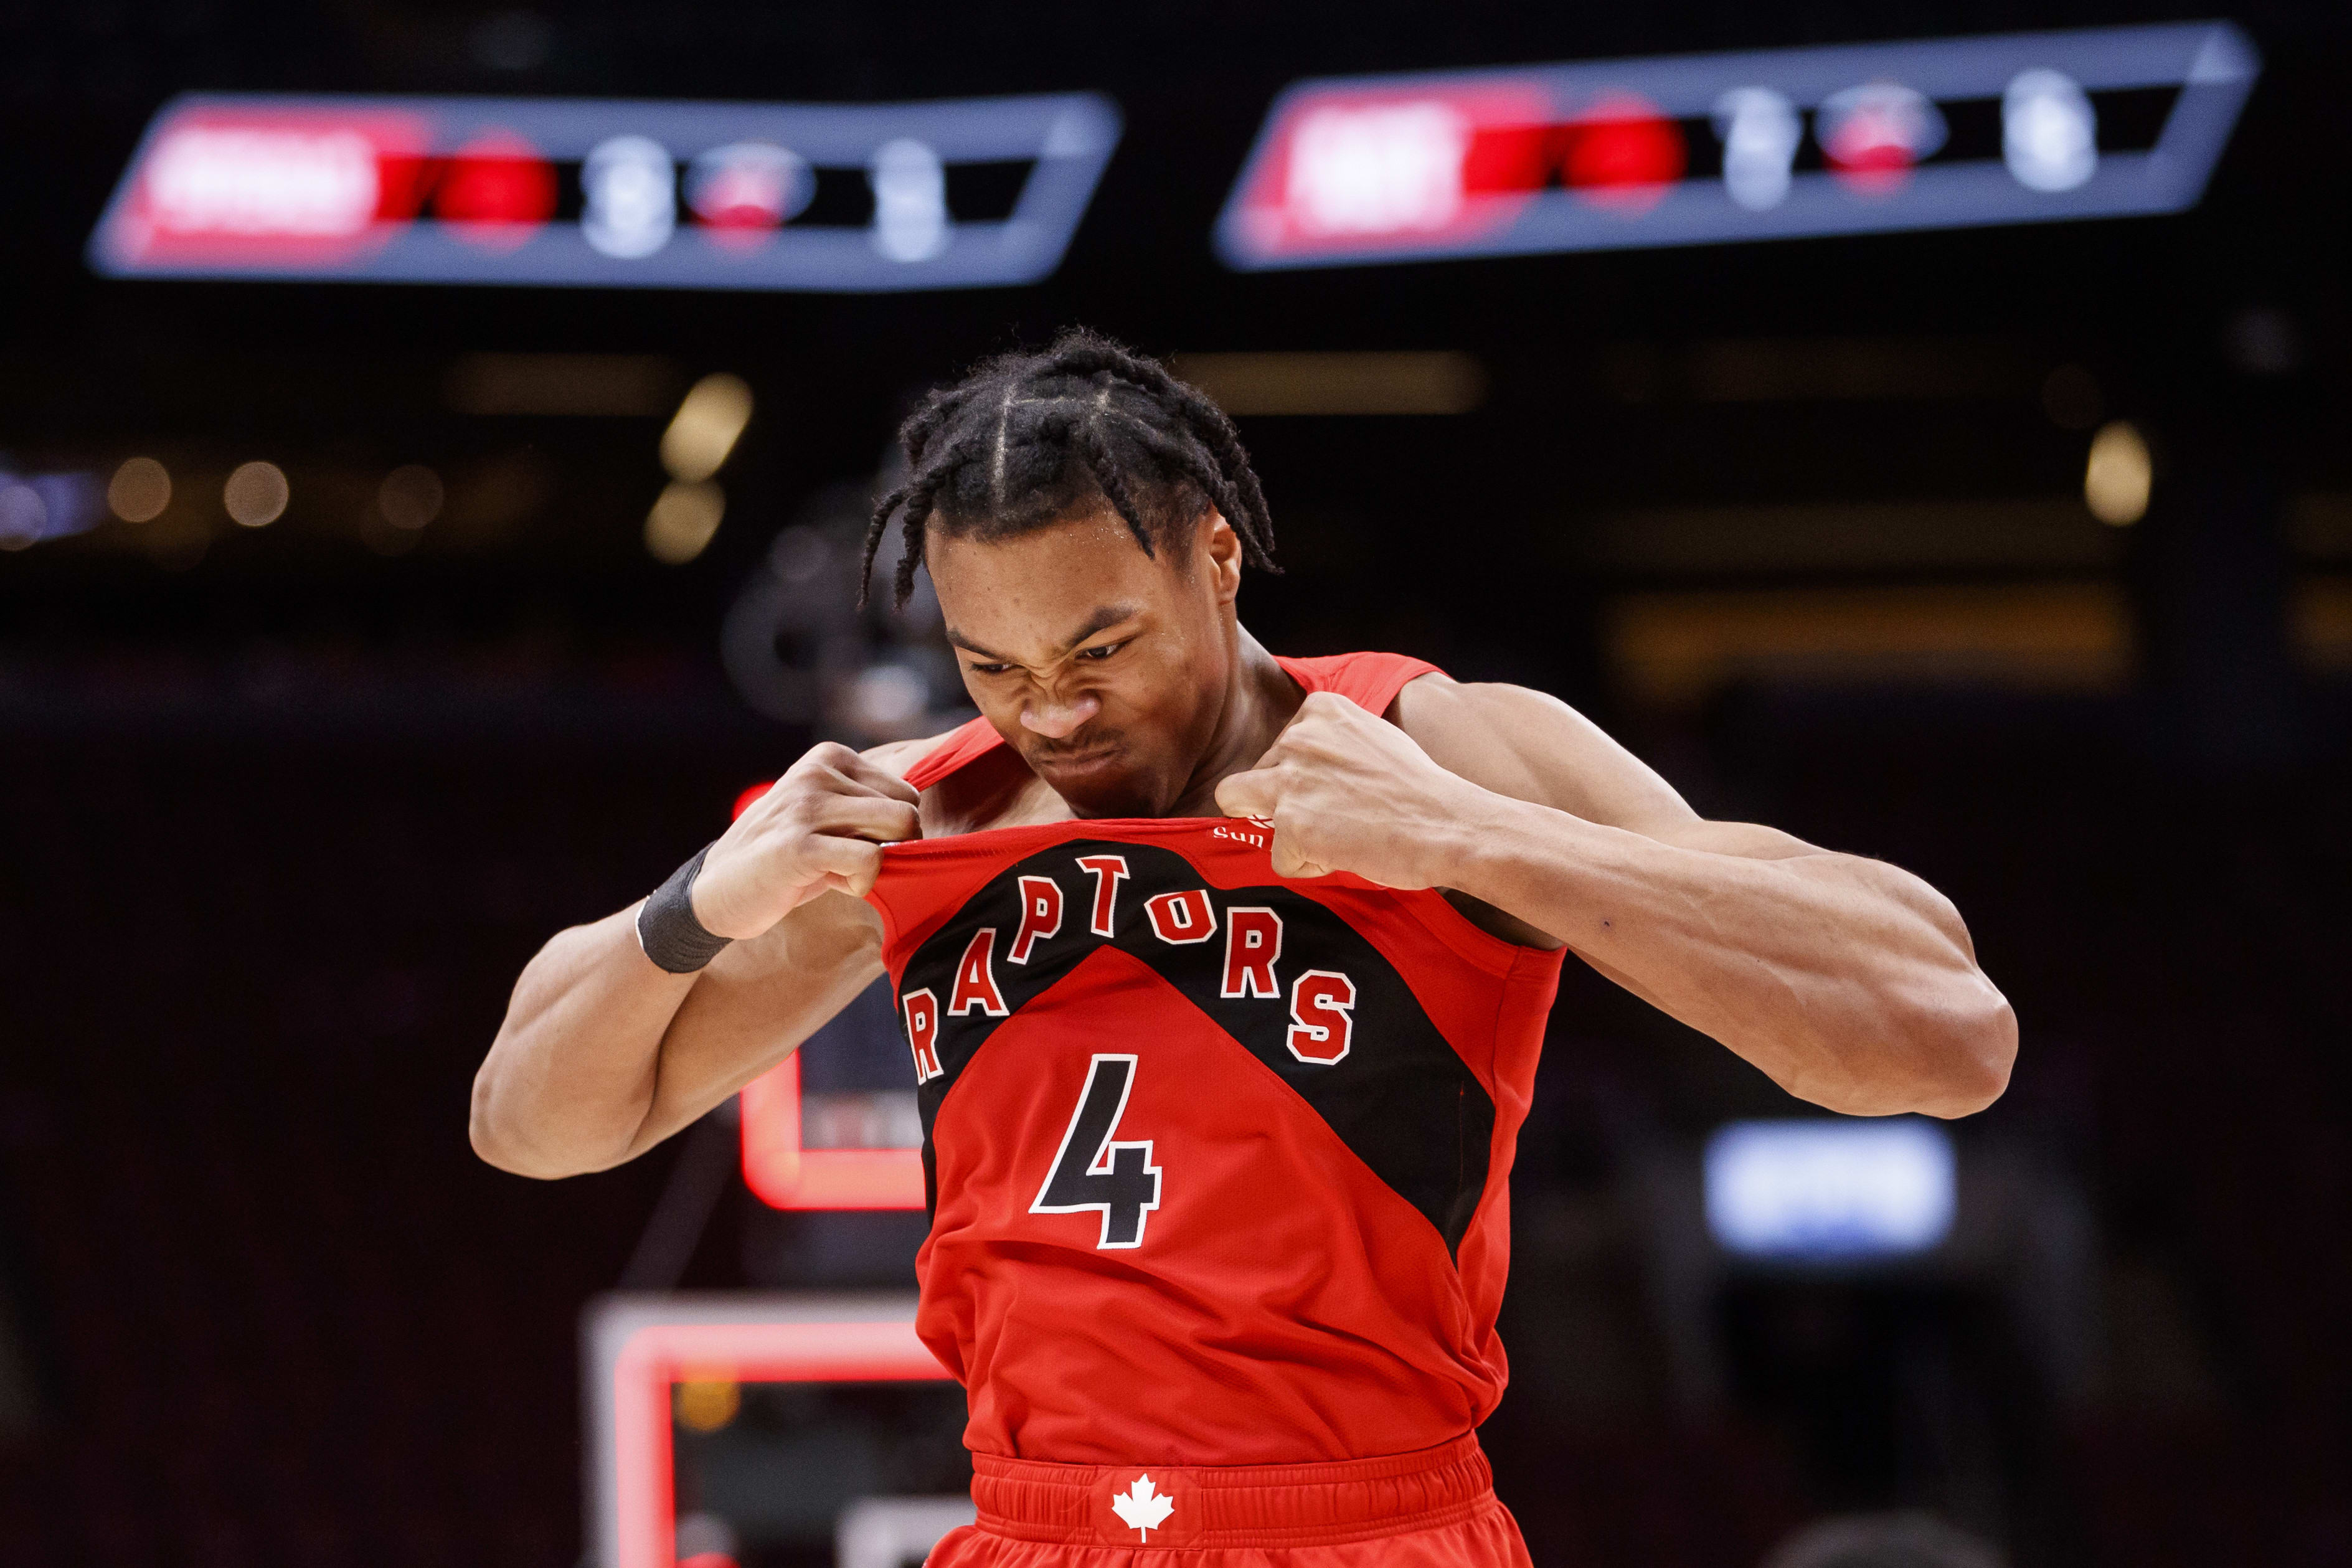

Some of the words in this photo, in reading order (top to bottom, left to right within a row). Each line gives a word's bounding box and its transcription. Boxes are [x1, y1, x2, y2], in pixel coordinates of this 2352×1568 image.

[1213, 826, 1264, 849] Sun
[903, 855, 1356, 1085] RAPTORS
[1029, 1053, 1163, 1249] 4
